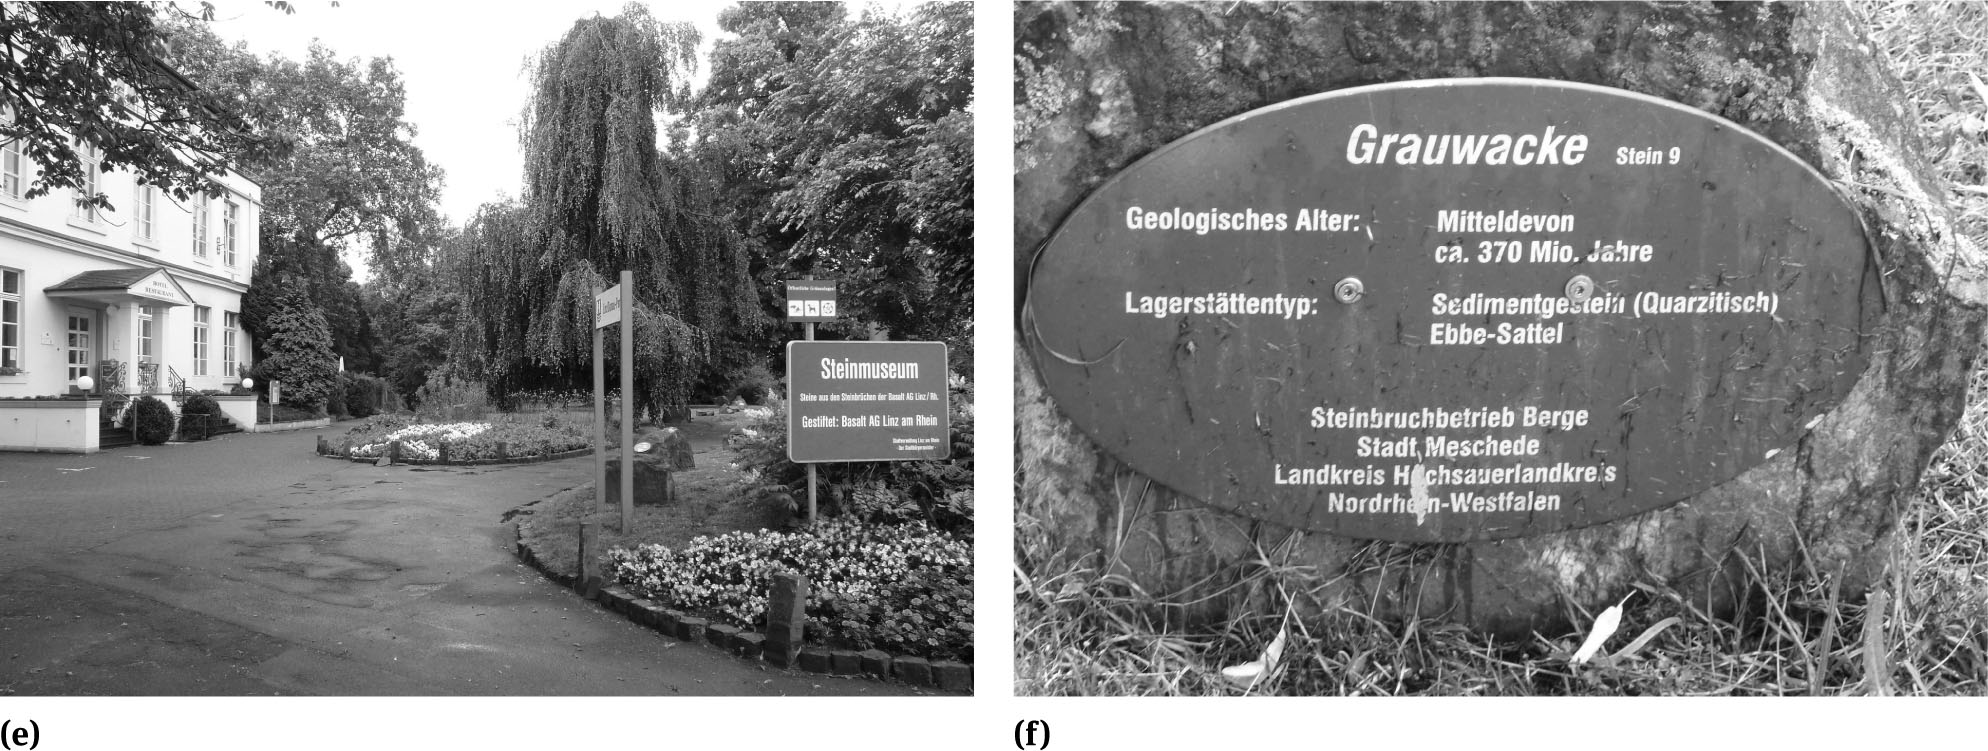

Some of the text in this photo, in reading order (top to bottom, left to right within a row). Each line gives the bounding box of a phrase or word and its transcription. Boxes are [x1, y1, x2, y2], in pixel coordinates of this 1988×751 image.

[1347, 124, 1680, 165] Grauwacke Stein 9
[1126, 206, 1359, 235] Geologisches Alter:
[1438, 210, 1574, 232] Mitteldevon
[1435, 240, 1653, 263] ca. 370 Mio. Jahre
[1126, 292, 1317, 319] Lagerstättentyp:
[1431, 291, 1779, 319] Sedimentgestein (Quarzitisch)
[1431, 322, 1563, 344] Ebbe-Sattel
[821, 358, 918, 379] Steinmuseum
[800, 393, 817, 401] Steine
[830, 393, 840, 401] den
[841, 393, 876, 401] Steinbrüchen
[878, 393, 887, 401] der
[888, 392, 905, 400] Basalt
[802, 415, 937, 428] Gestiftet: Basalt AG Linz am Rhein
[1311, 406, 1588, 431] Steinbruchbetrieb Berge
[1357, 436, 1540, 458] Stadt Meschede
[1275, 463, 1617, 486] Landkreis Hchsauerlandkreis
[1328, 491, 1561, 513] Nordrhen-Westfalen
